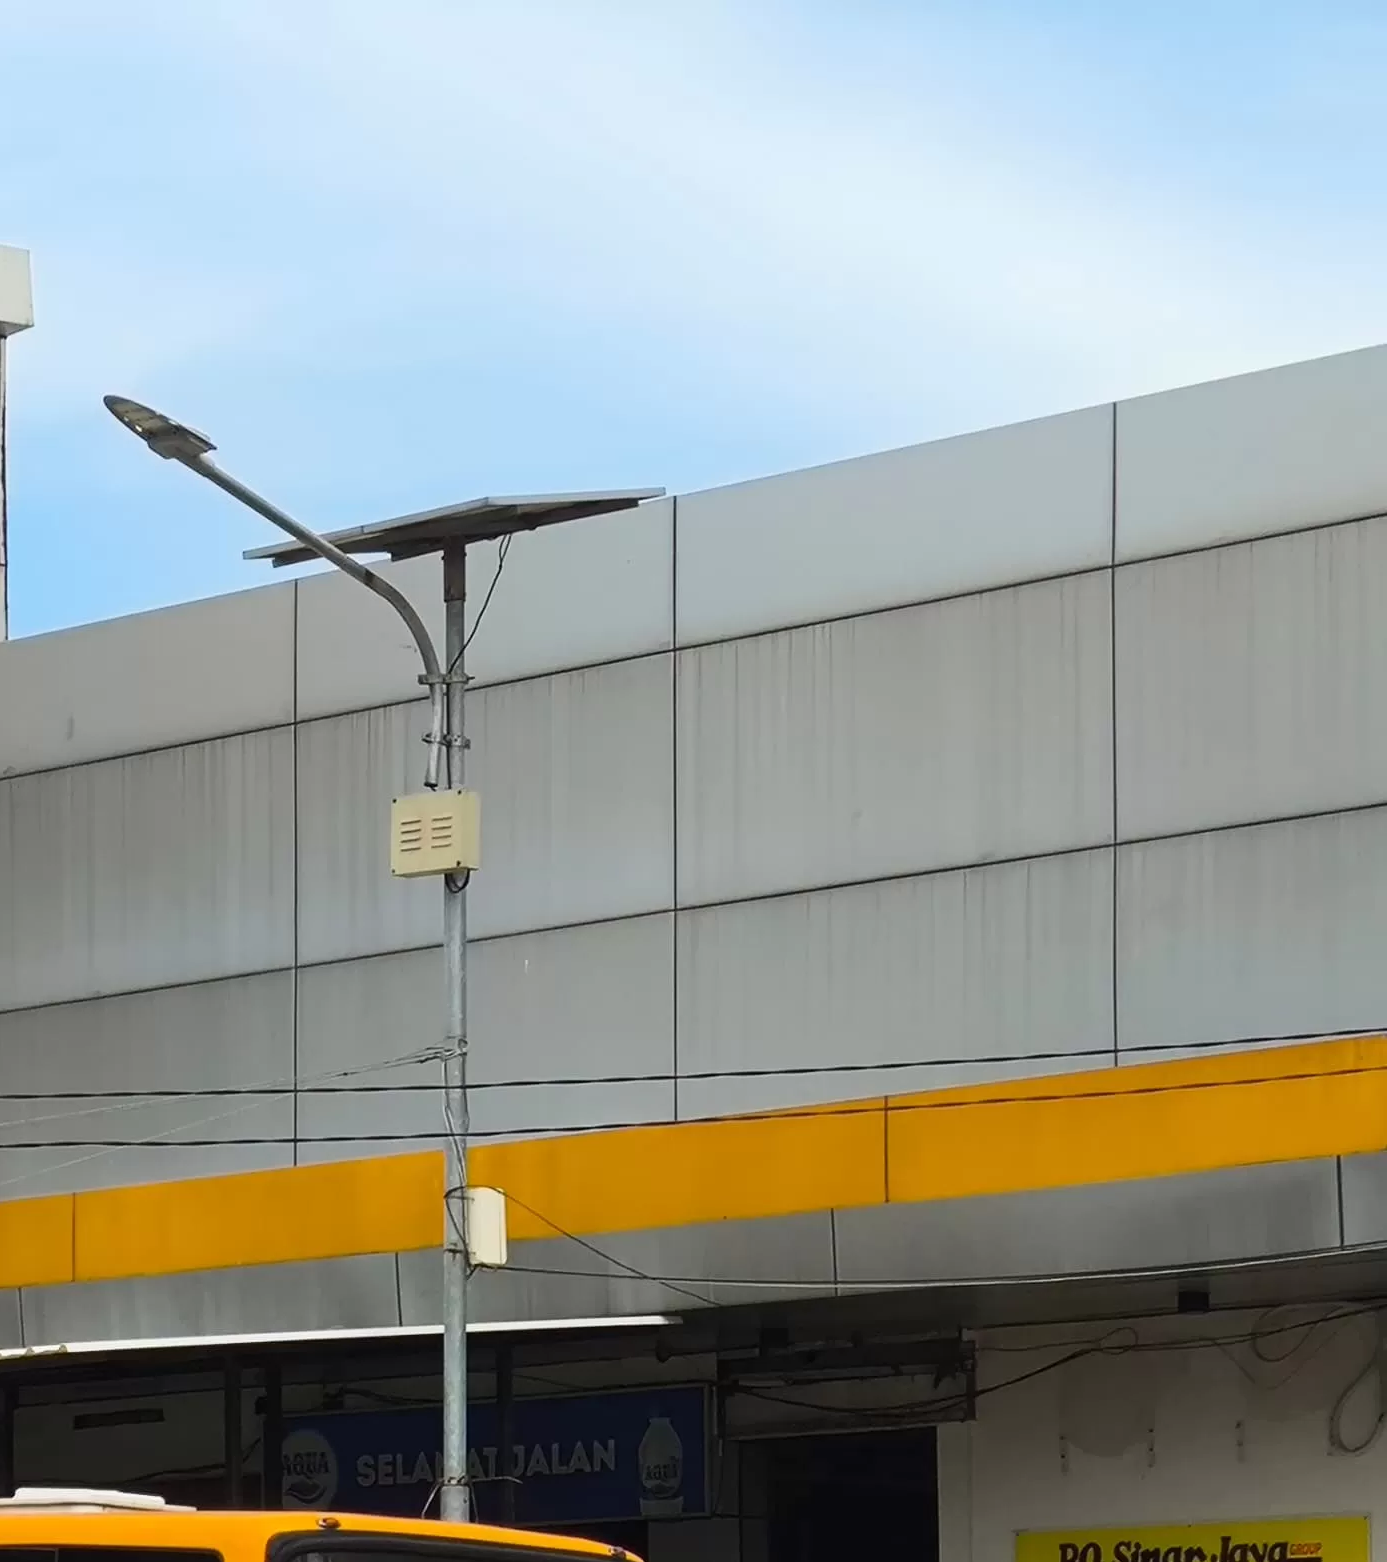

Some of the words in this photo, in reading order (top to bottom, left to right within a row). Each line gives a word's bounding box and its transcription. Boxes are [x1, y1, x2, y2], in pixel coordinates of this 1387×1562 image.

[356, 1445, 498, 1487] SELAAT
[511, 1438, 616, 1476] JALAN
[1289, 1541, 1323, 1556] GROUP
